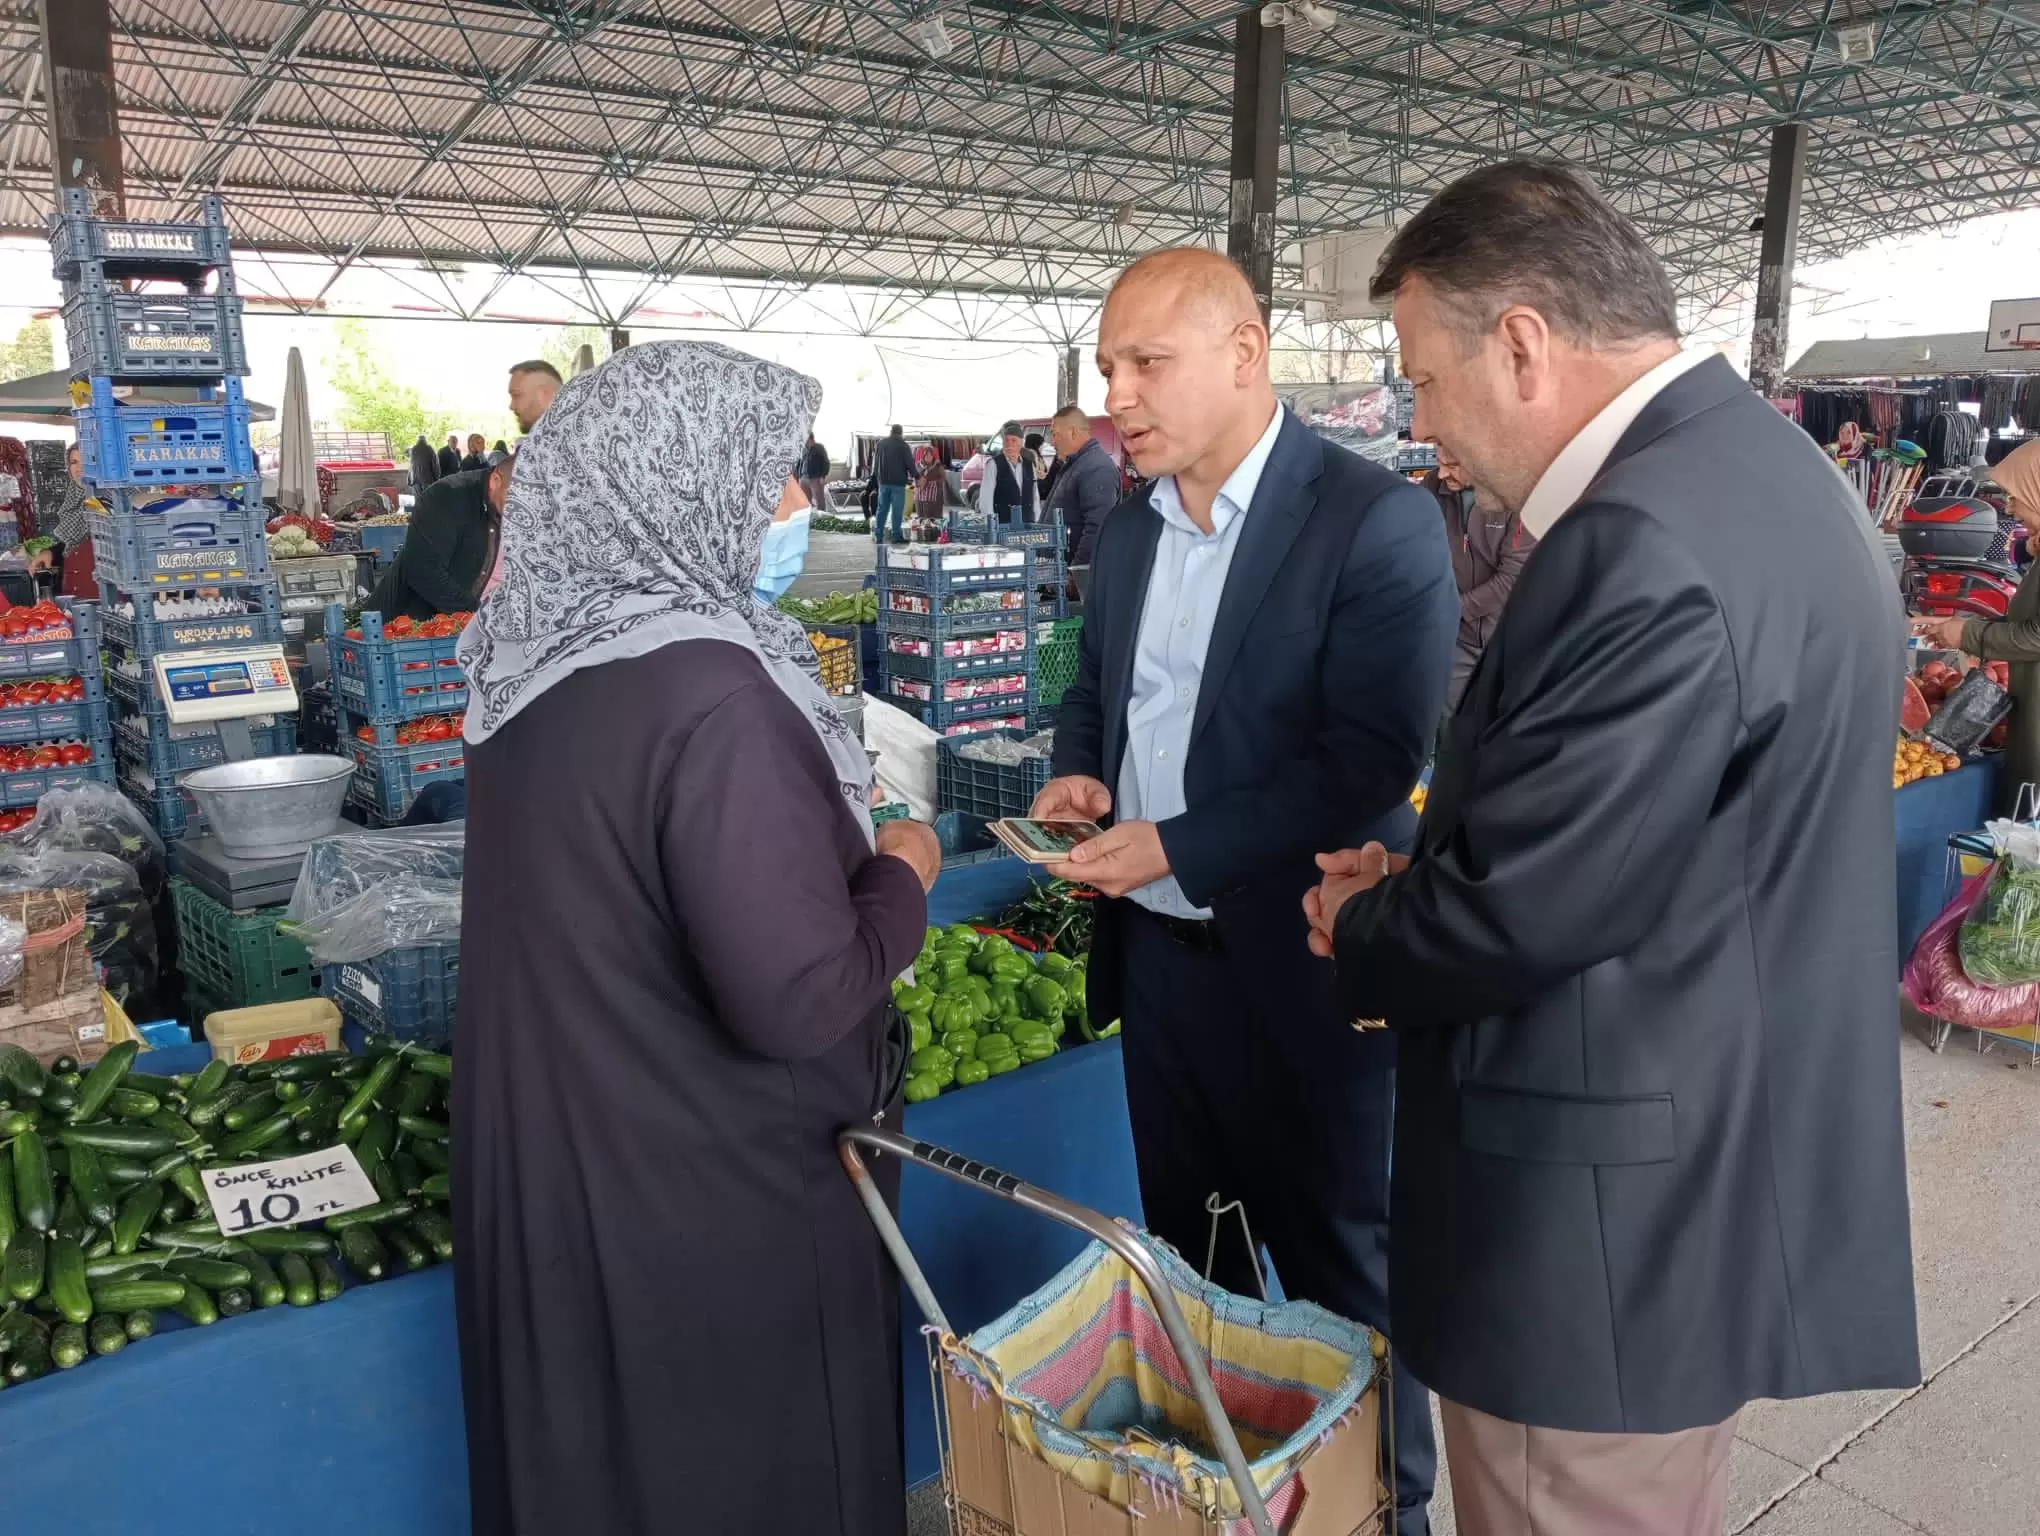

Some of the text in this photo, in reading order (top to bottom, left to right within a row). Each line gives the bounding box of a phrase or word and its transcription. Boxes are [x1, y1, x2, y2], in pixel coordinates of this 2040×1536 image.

[235, 624, 253, 639] 96
[214, 1161, 346, 1190] ÖNCE KALİTE
[227, 1193, 345, 1231] 10 TL
